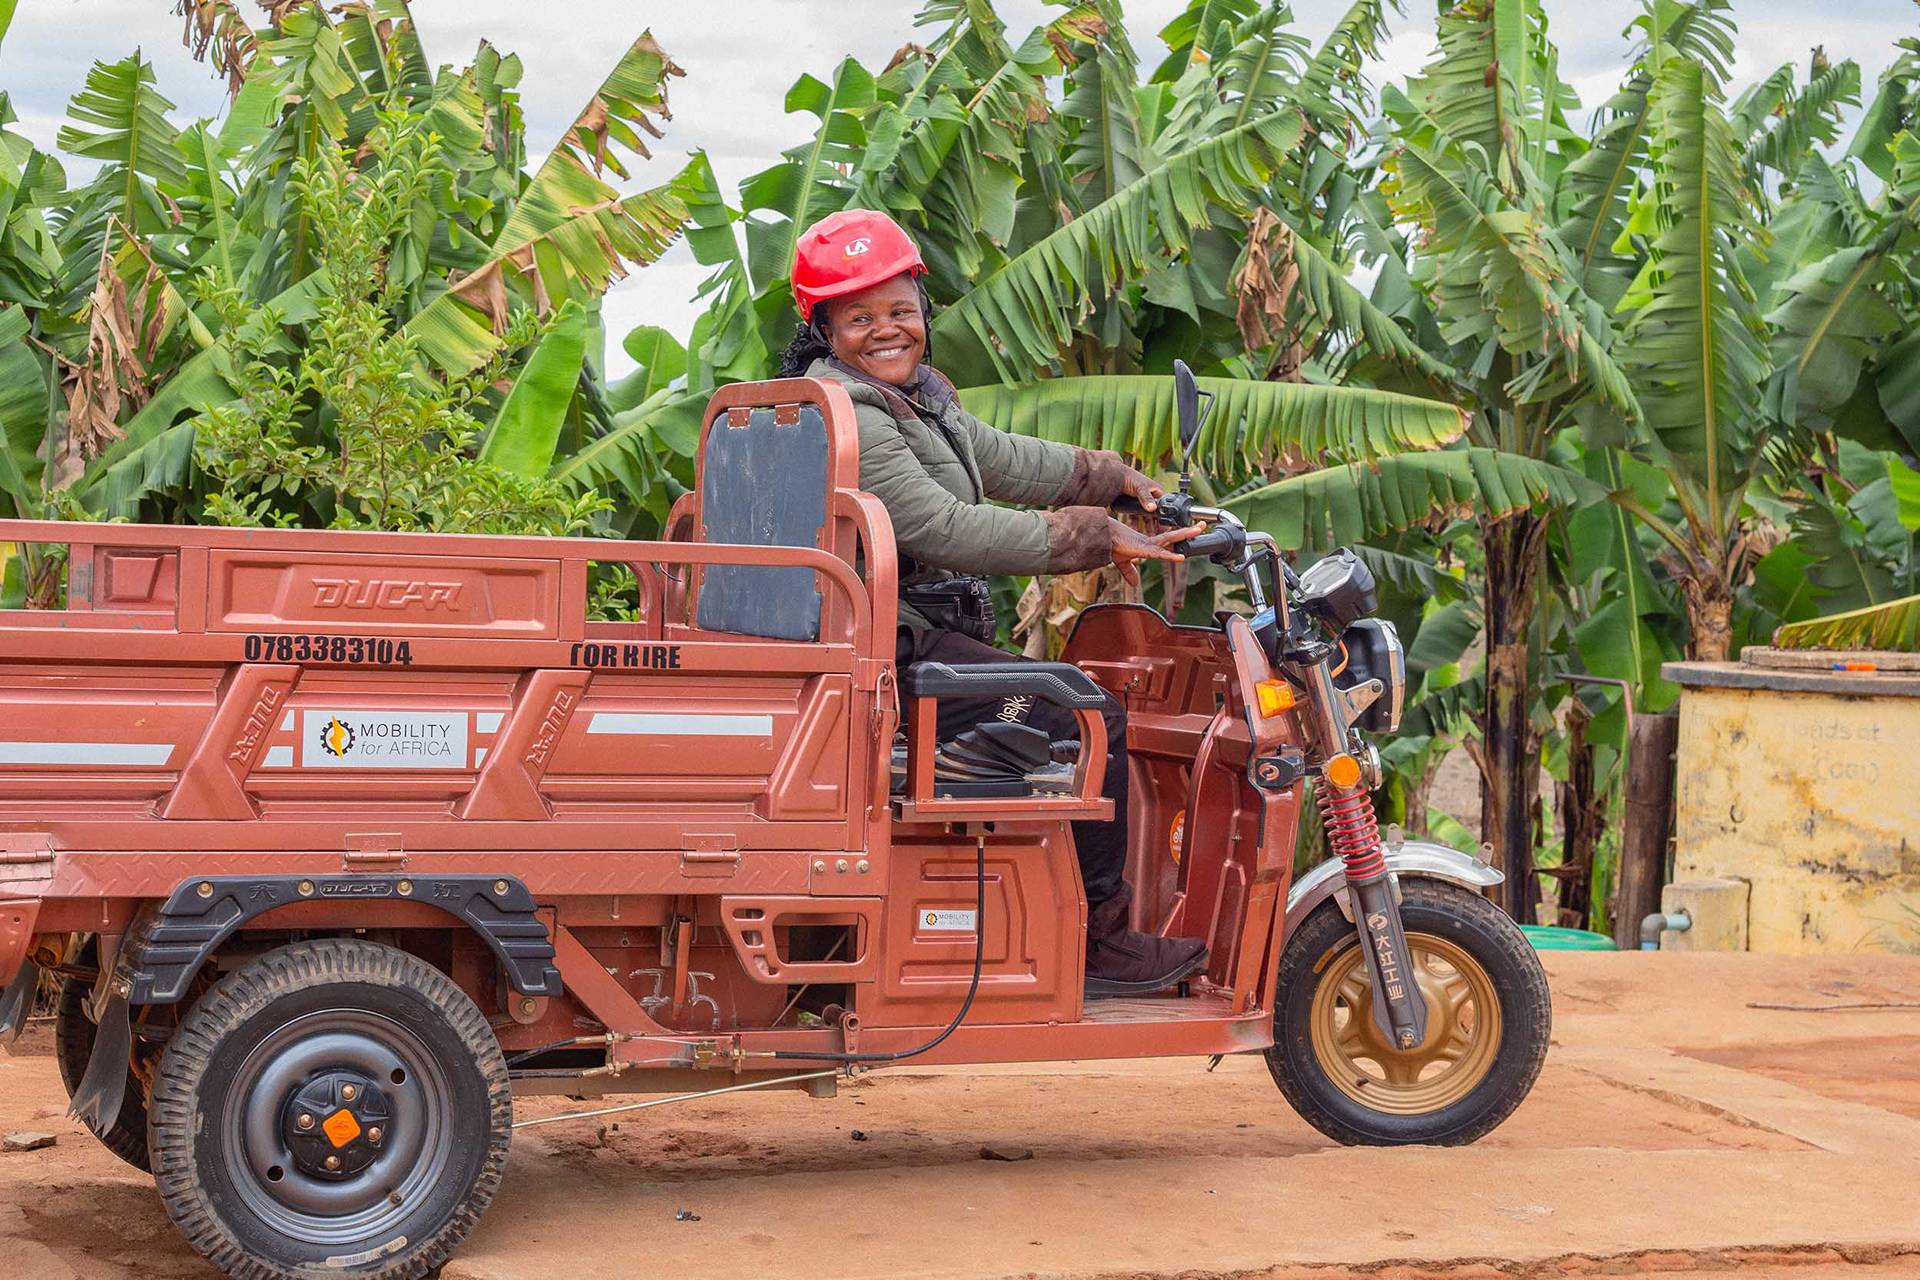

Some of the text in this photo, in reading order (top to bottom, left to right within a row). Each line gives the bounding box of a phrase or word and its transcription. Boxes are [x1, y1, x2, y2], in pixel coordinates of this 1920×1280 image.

[311, 578, 463, 612] DUCAR
[244, 635, 413, 665] 0783383104
[570, 643, 681, 669] FOR HIRE
[360, 723, 451, 739] MOBILITY
[360, 741, 452, 756] for AFRICA
